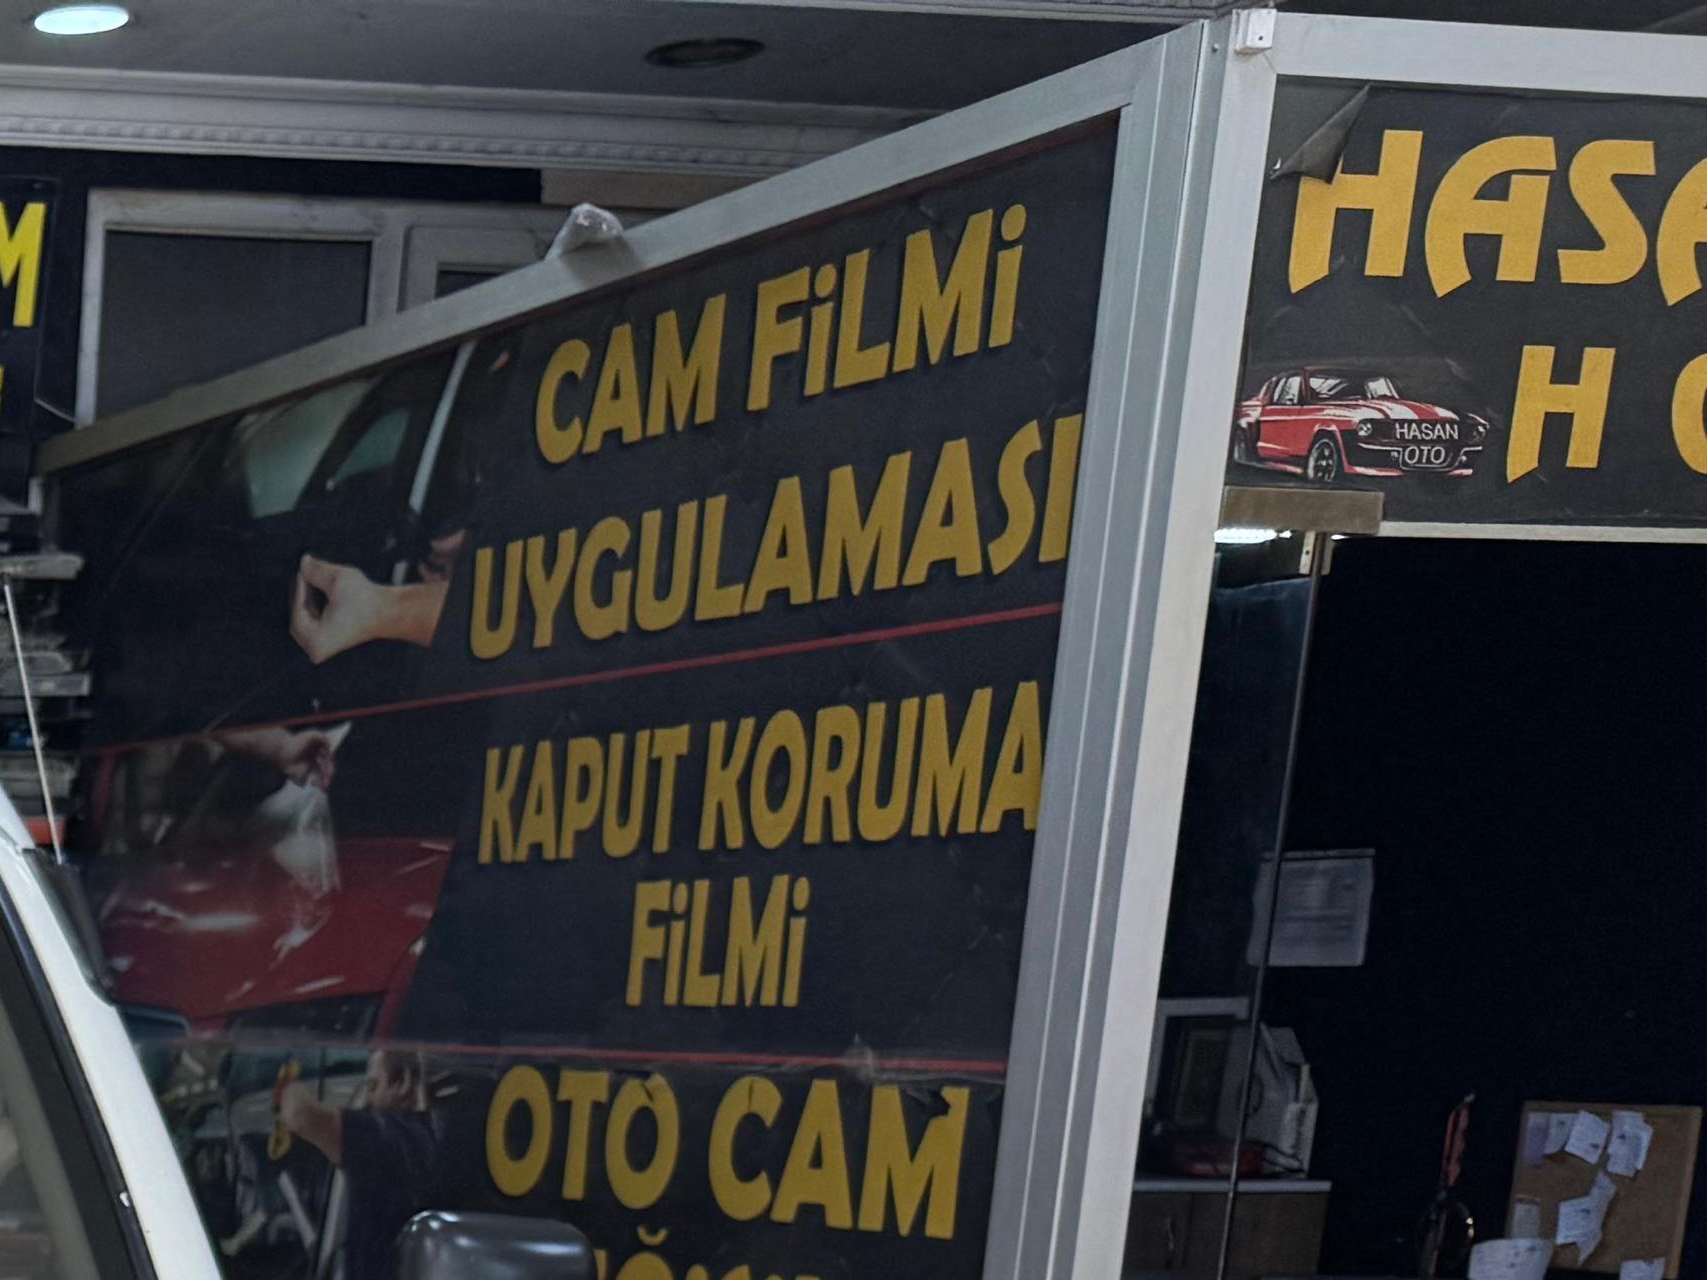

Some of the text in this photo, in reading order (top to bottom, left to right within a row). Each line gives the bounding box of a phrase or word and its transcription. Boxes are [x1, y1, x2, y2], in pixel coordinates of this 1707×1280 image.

[535, 292, 727, 466] CAM
[1395, 421, 1459, 441] HASAN
[1403, 446, 1446, 465] OTO
[469, 412, 1083, 660] UYGULAMASI
[477, 680, 1045, 865] KAPUT KORUMA
[485, 1065, 971, 1240] OTO CAM
